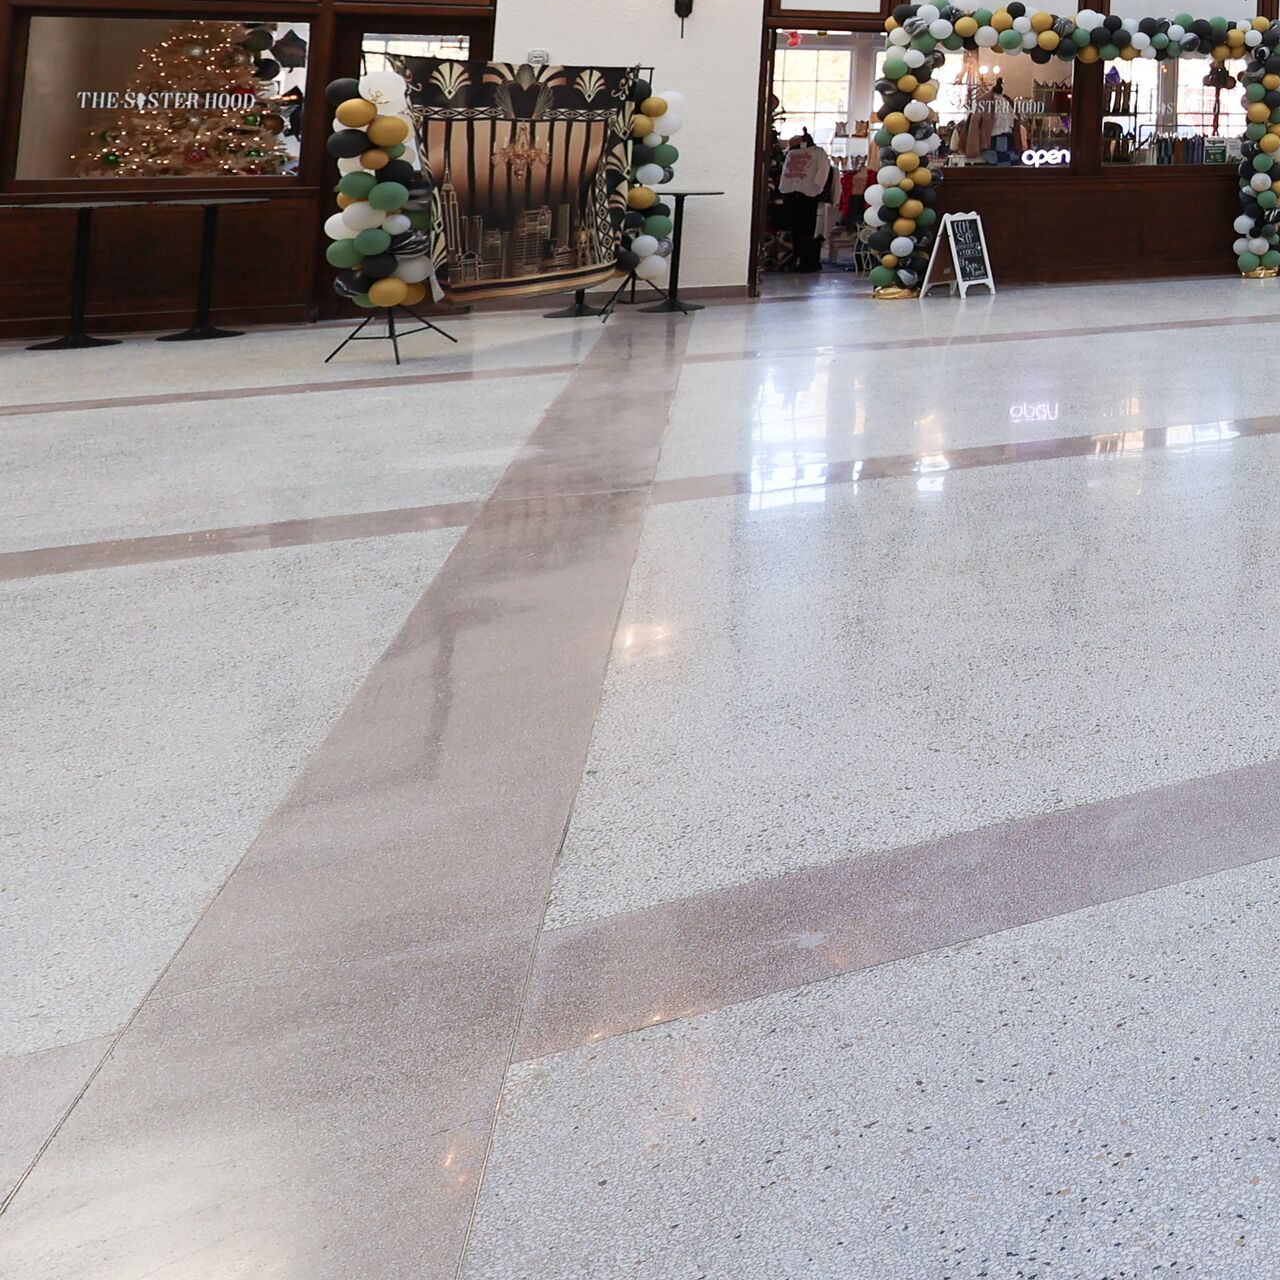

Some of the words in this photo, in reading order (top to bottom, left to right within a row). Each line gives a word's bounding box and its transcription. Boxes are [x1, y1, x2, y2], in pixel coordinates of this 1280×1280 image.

[77, 91, 119, 109] THE
[204, 92, 256, 110] HOOD
[1021, 149, 1071, 168] open
